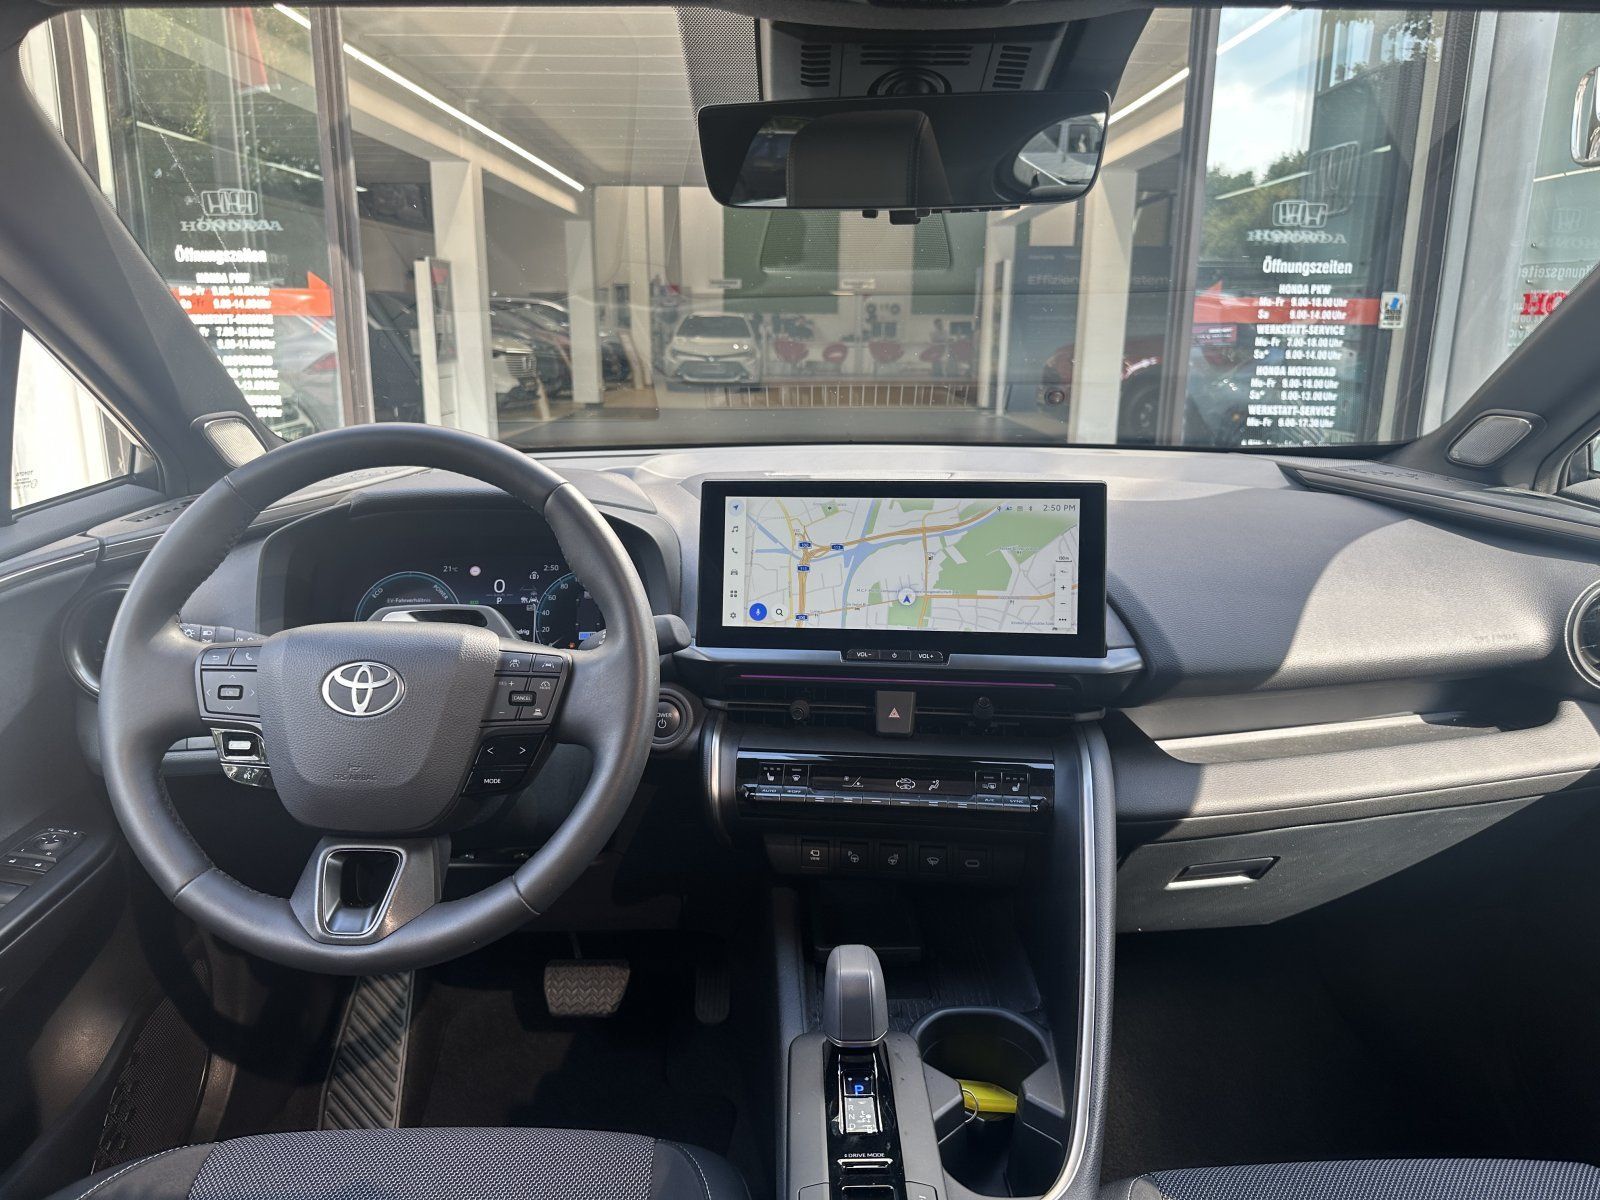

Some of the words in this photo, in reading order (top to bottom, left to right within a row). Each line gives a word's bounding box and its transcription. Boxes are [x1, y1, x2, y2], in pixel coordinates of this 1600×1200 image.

[1262, 256, 1353, 276] Öffnungszeiten
[1279, 284, 1309, 294] HONDA
[1310, 284, 1332, 294] PKW
[1258, 309, 1270, 319] Sa
[1256, 324, 1346, 335] WERKSTATT-SERVICE
[1254, 337, 1281, 346] Mo-Fr
[1329, 338, 1344, 348] Uhr
[1328, 350, 1343, 360] Uhr
[1256, 366, 1286, 376] HONDA
[1287, 366, 1336, 376] MOTORRAD
[1250, 378, 1277, 388] Mo-Fr
[1324, 379, 1339, 389] Uhr
[1322, 391, 1338, 401] Uhr
[1248, 404, 1336, 416] WERKSTATT-SERVICE
[1246, 417, 1272, 427] Mo-Fr
[1320, 418, 1335, 428] Uhr
[432, 584, 448, 600] POWER
[494, 579, 506, 594] 0
[372, 587, 384, 598] ECO
[854, 1084, 864, 1096] P
